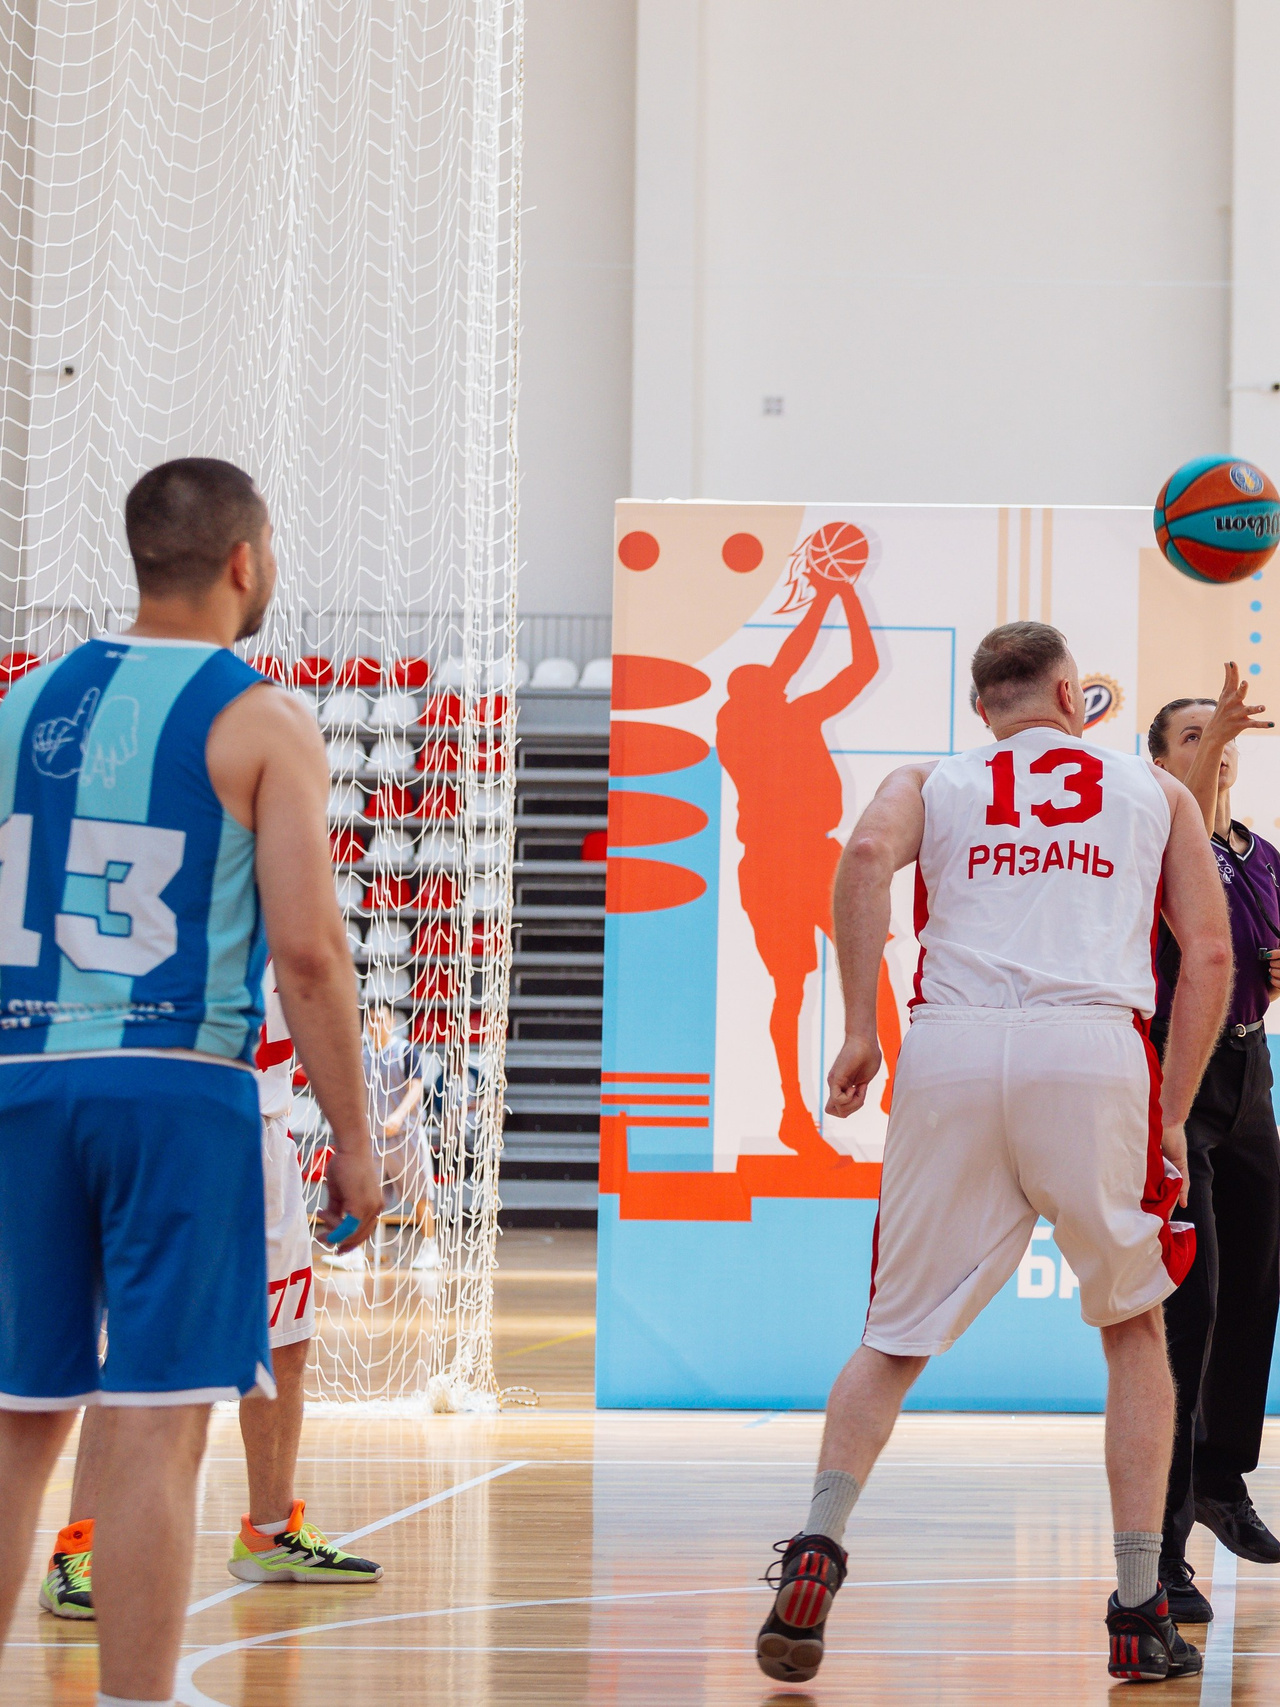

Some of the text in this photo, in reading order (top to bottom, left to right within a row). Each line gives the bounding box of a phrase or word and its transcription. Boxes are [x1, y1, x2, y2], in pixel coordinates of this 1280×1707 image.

[985, 747, 1103, 828] 13
[0, 813, 187, 977] 13
[968, 840, 1114, 879] РЯЗАНЬ
[269, 1266, 312, 1329] 77
